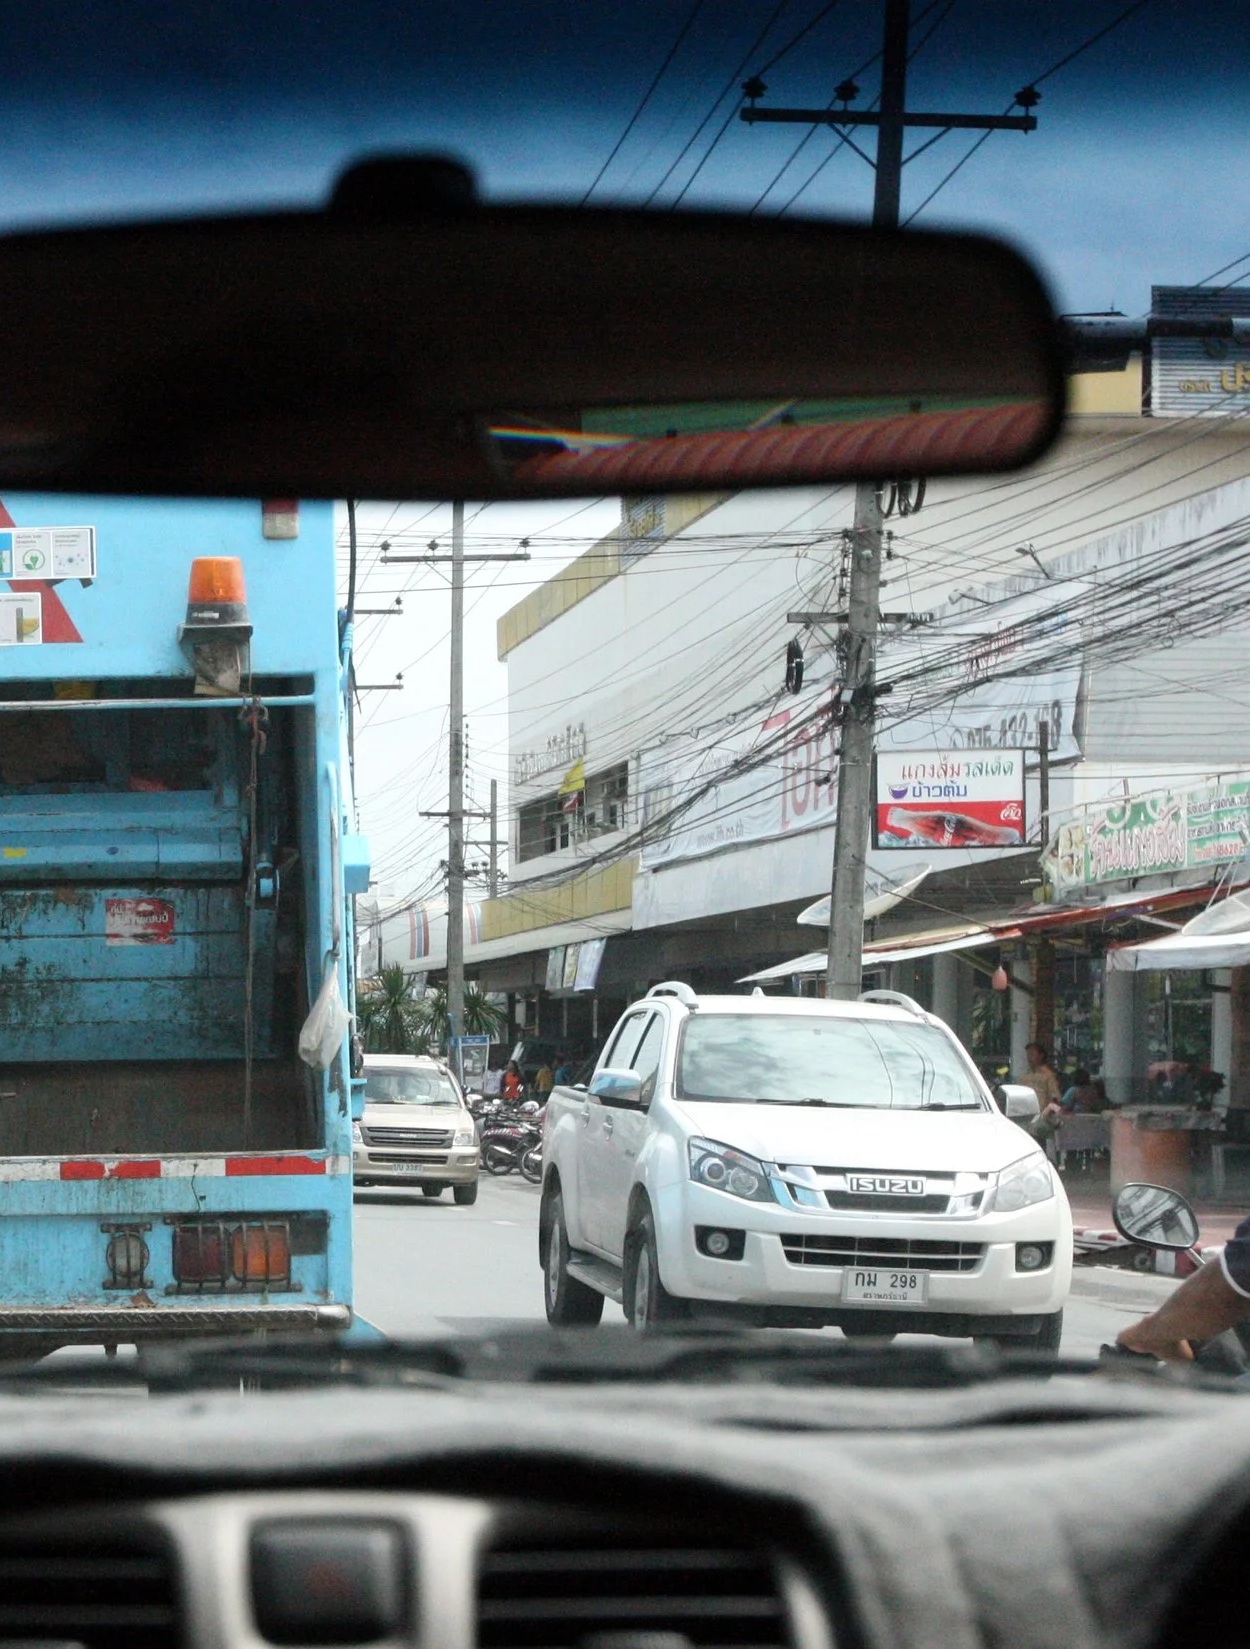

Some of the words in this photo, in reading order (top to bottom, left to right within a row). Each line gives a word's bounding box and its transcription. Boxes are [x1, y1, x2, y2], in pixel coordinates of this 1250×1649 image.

[912, 781, 968, 798] ข้าวต้ม
[851, 1177, 924, 1193] ISUZU
[855, 1272, 877, 1287] กม
[890, 1273, 917, 1288] 298
